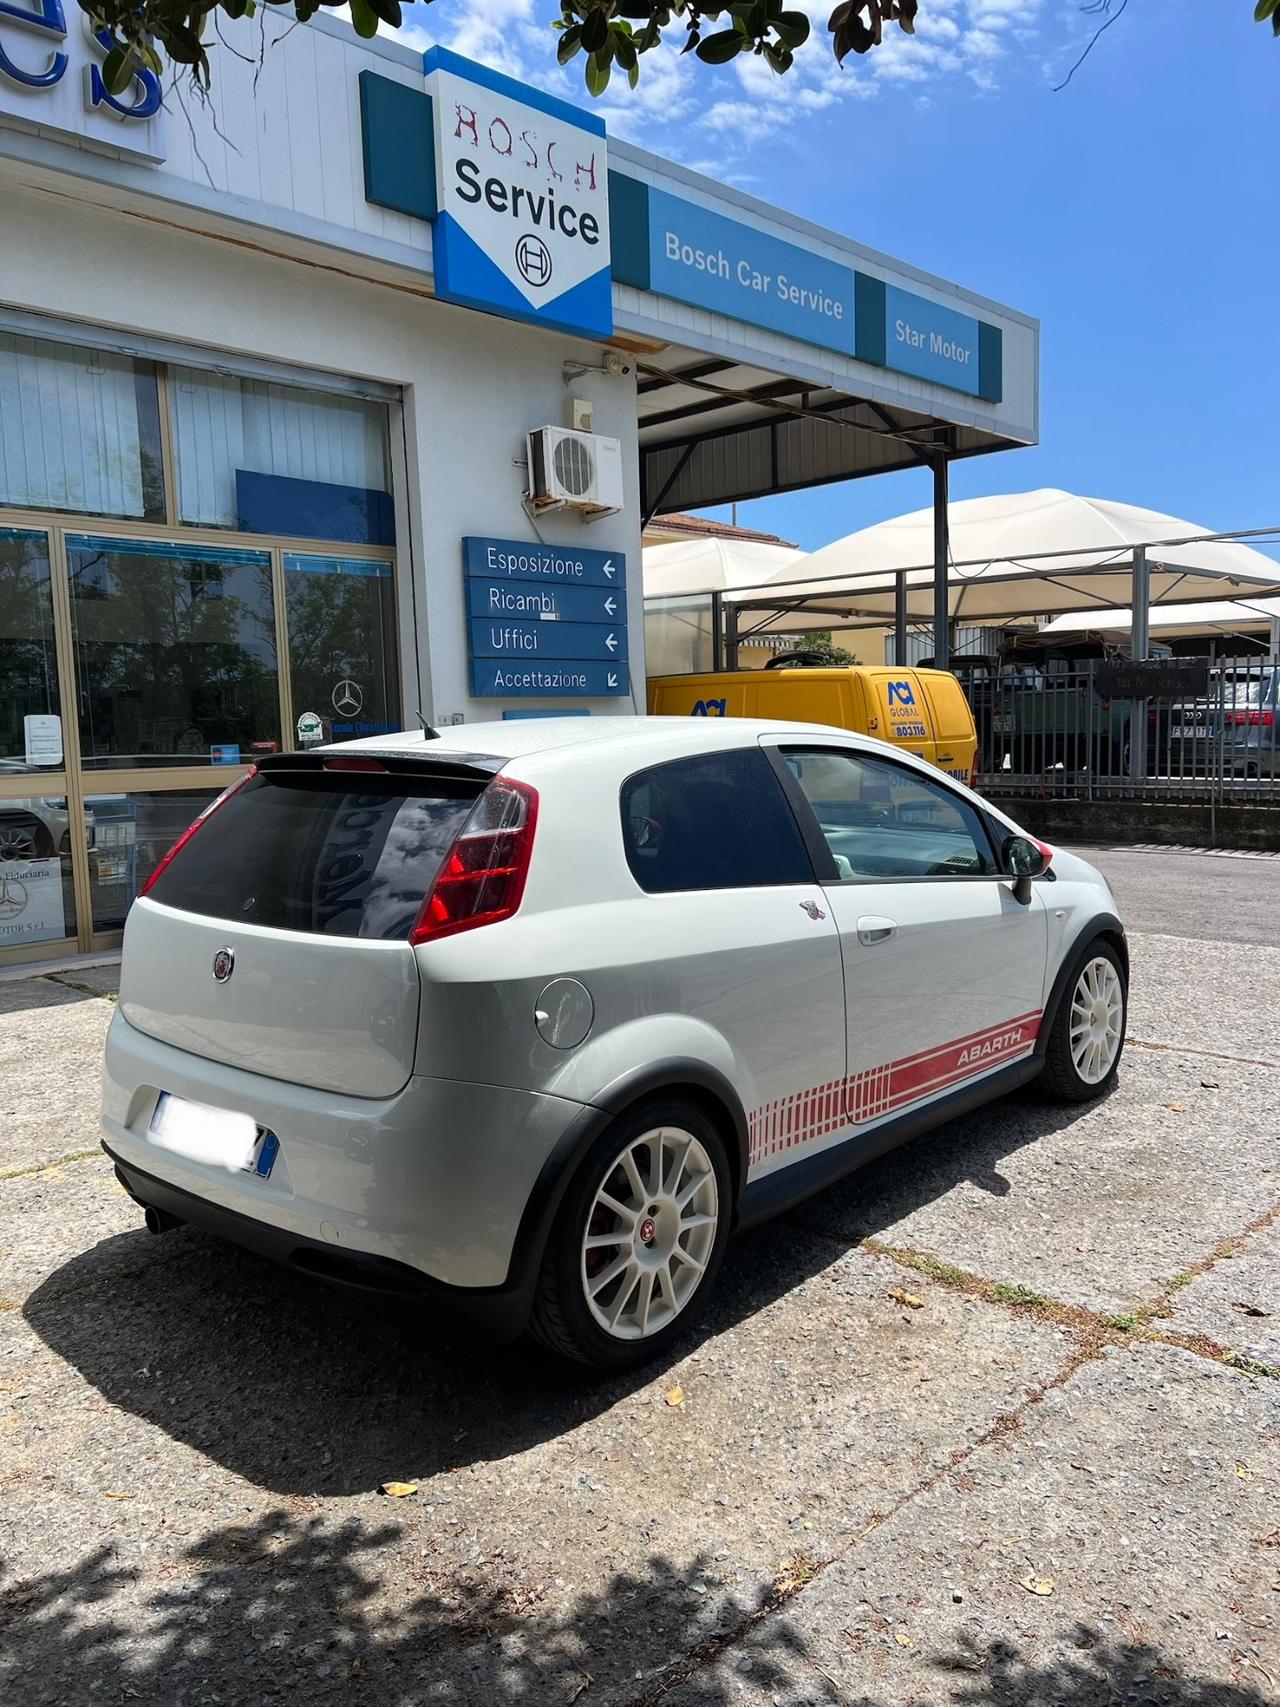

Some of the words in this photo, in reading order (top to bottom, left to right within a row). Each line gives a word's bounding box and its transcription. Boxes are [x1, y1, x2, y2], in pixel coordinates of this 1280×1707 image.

[455, 158, 600, 245] Service
[664, 231, 730, 281] Bosch
[737, 260, 772, 295] Car
[777, 275, 844, 320] Service
[895, 319, 926, 350] Star
[930, 331, 971, 365] Motor
[487, 547, 584, 577] Esposizione
[489, 588, 556, 612] Ricambi
[491, 628, 538, 650] Uffici
[494, 670, 587, 688] Accettazione
[890, 708, 919, 717] GLOBAL
[944, 769, 969, 781] OBILE
[5, 867, 50, 880] Fiduciaria
[957, 1029, 1022, 1066] ABARTH
